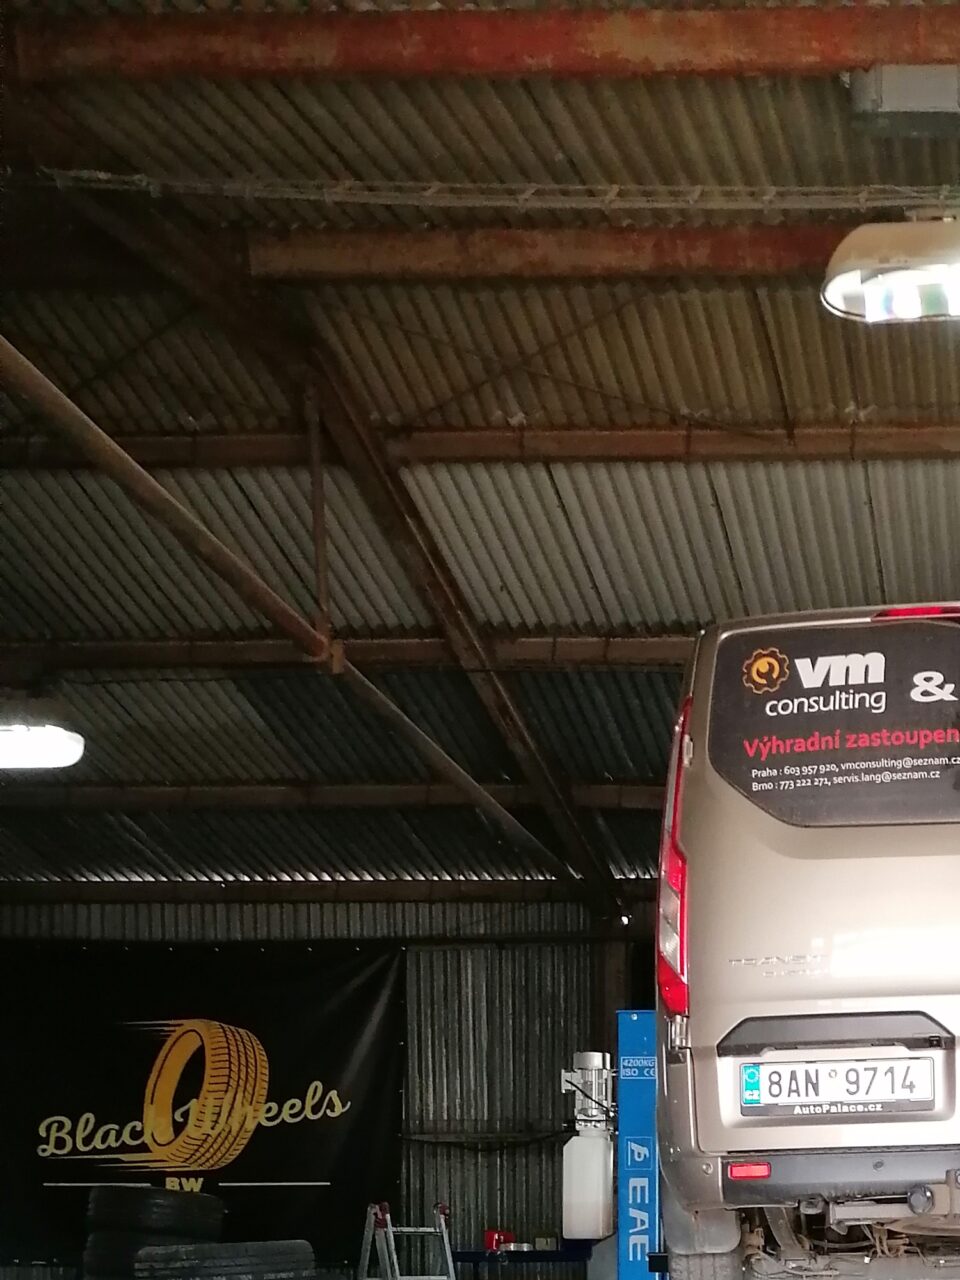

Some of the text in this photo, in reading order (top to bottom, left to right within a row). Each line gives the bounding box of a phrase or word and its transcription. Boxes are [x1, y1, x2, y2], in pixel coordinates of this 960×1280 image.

[794, 652, 886, 689] vm
[910, 671, 959, 702] &
[765, 690, 886, 716] consulting
[743, 729, 841, 761] Výhradní
[752, 767, 778, 779] Praha
[784, 765, 800, 776] 603
[802, 765, 818, 776] 957
[752, 782, 774, 792] Brno
[779, 780, 795, 790] 773
[796, 778, 812, 787] 222
[833, 770, 941, 784] servis.lang@seznam.cz
[768, 1066, 916, 1098] 8AN 9714
[793, 1103, 883, 1115] AutoPalace.cz
[165, 1177, 204, 1192] BW
[628, 1177, 649, 1262] EAE
